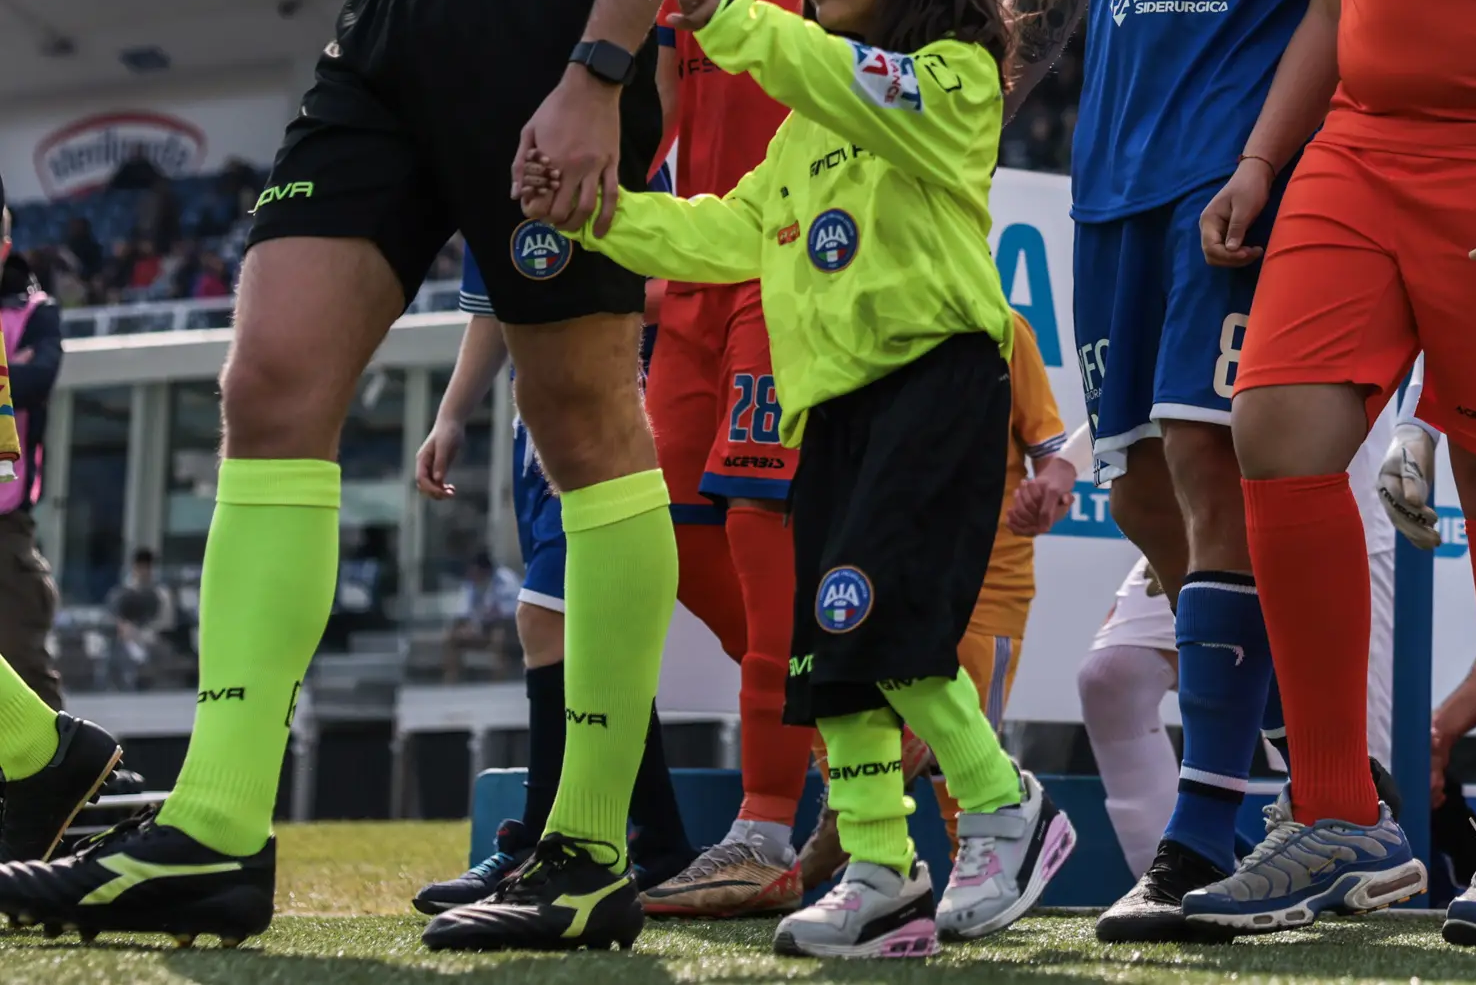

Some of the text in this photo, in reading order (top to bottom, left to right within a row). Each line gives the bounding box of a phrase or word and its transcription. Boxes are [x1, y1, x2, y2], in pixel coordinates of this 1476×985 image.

[1135, 0, 1229, 14] SIDERURGICA
[520, 233, 560, 257] AIA
[815, 224, 849, 252] AIA
[728, 373, 783, 444] 28
[723, 457, 785, 469] ACERBIS
[823, 582, 860, 608] AIA
